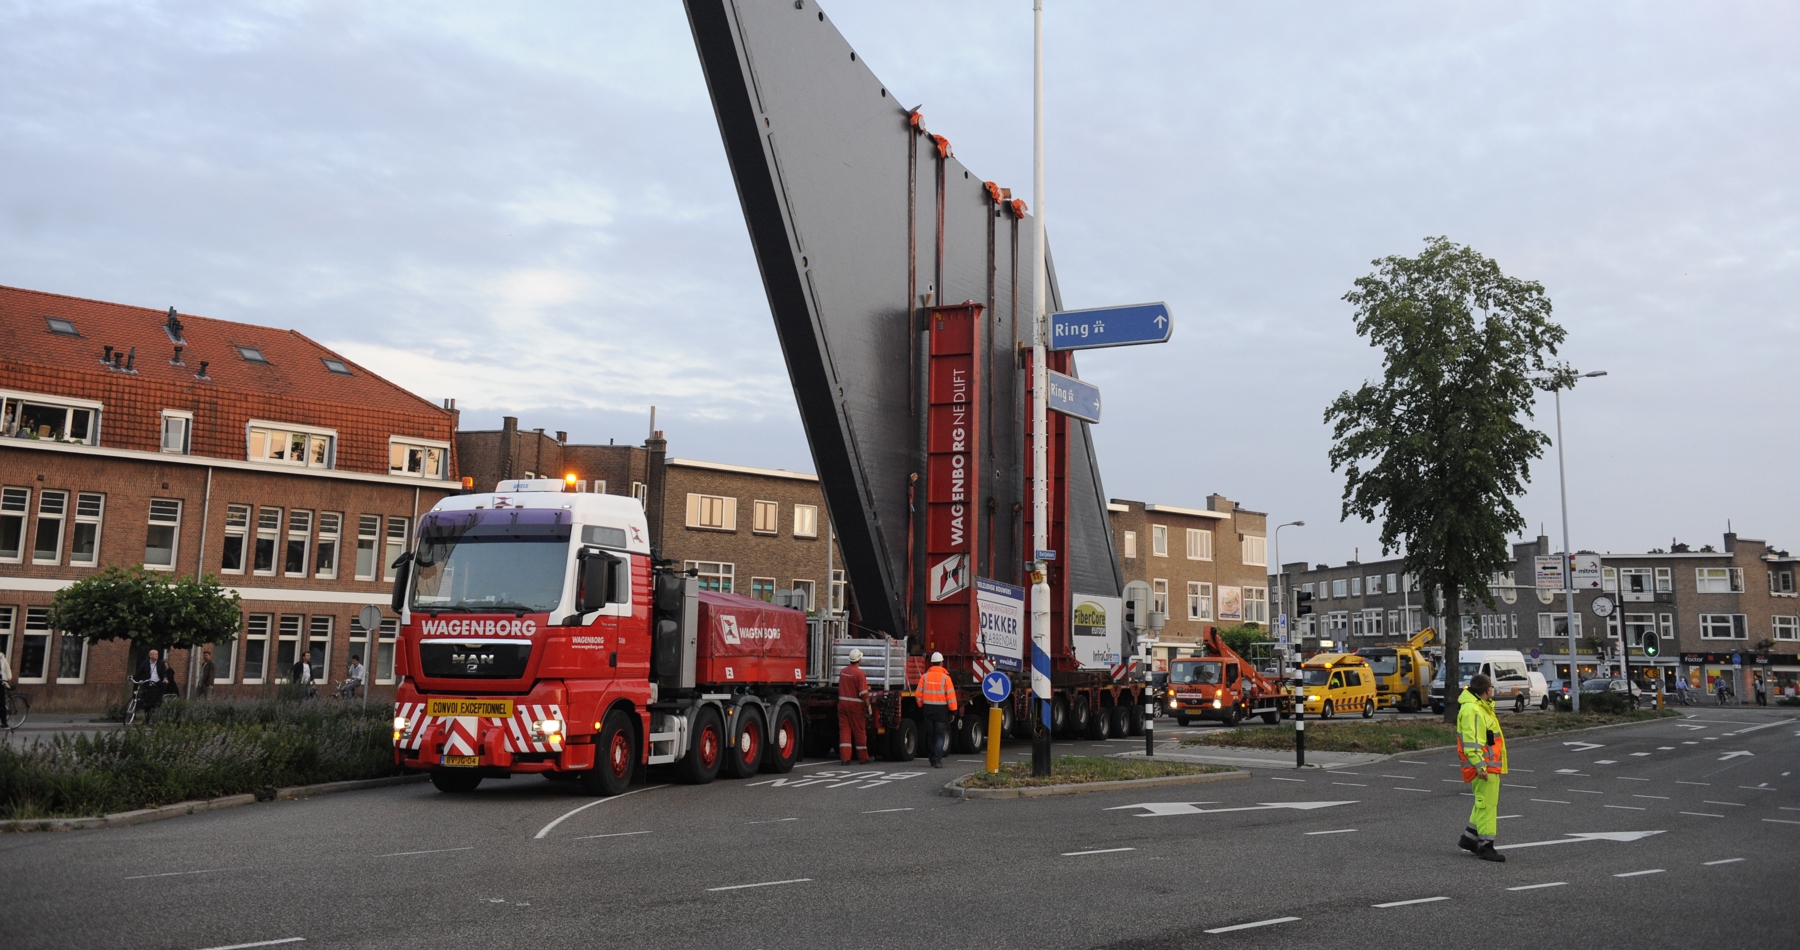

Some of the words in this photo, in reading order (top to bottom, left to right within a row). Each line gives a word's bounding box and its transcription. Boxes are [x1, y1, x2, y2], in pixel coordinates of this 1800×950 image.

[1055, 322, 1089, 338] Ring
[952, 368, 966, 425] NEDLIFT
[1050, 382, 1067, 403] Ring
[951, 427, 965, 546] WAGENBORG
[981, 612, 1017, 635] DEKKER
[1074, 609, 1106, 626] FiberCore
[421, 619, 537, 636] WAGENBORG
[739, 627, 781, 639] WAGENBORG
[1091, 627, 1106, 635] europe
[571, 636, 604, 644] WAGENBORG
[982, 631, 1018, 648] RABBENDAM
[452, 654, 494, 664] MAN
[432, 702, 458, 713] CONVOI
[460, 702, 507, 715] EXCEPTIONNEL
